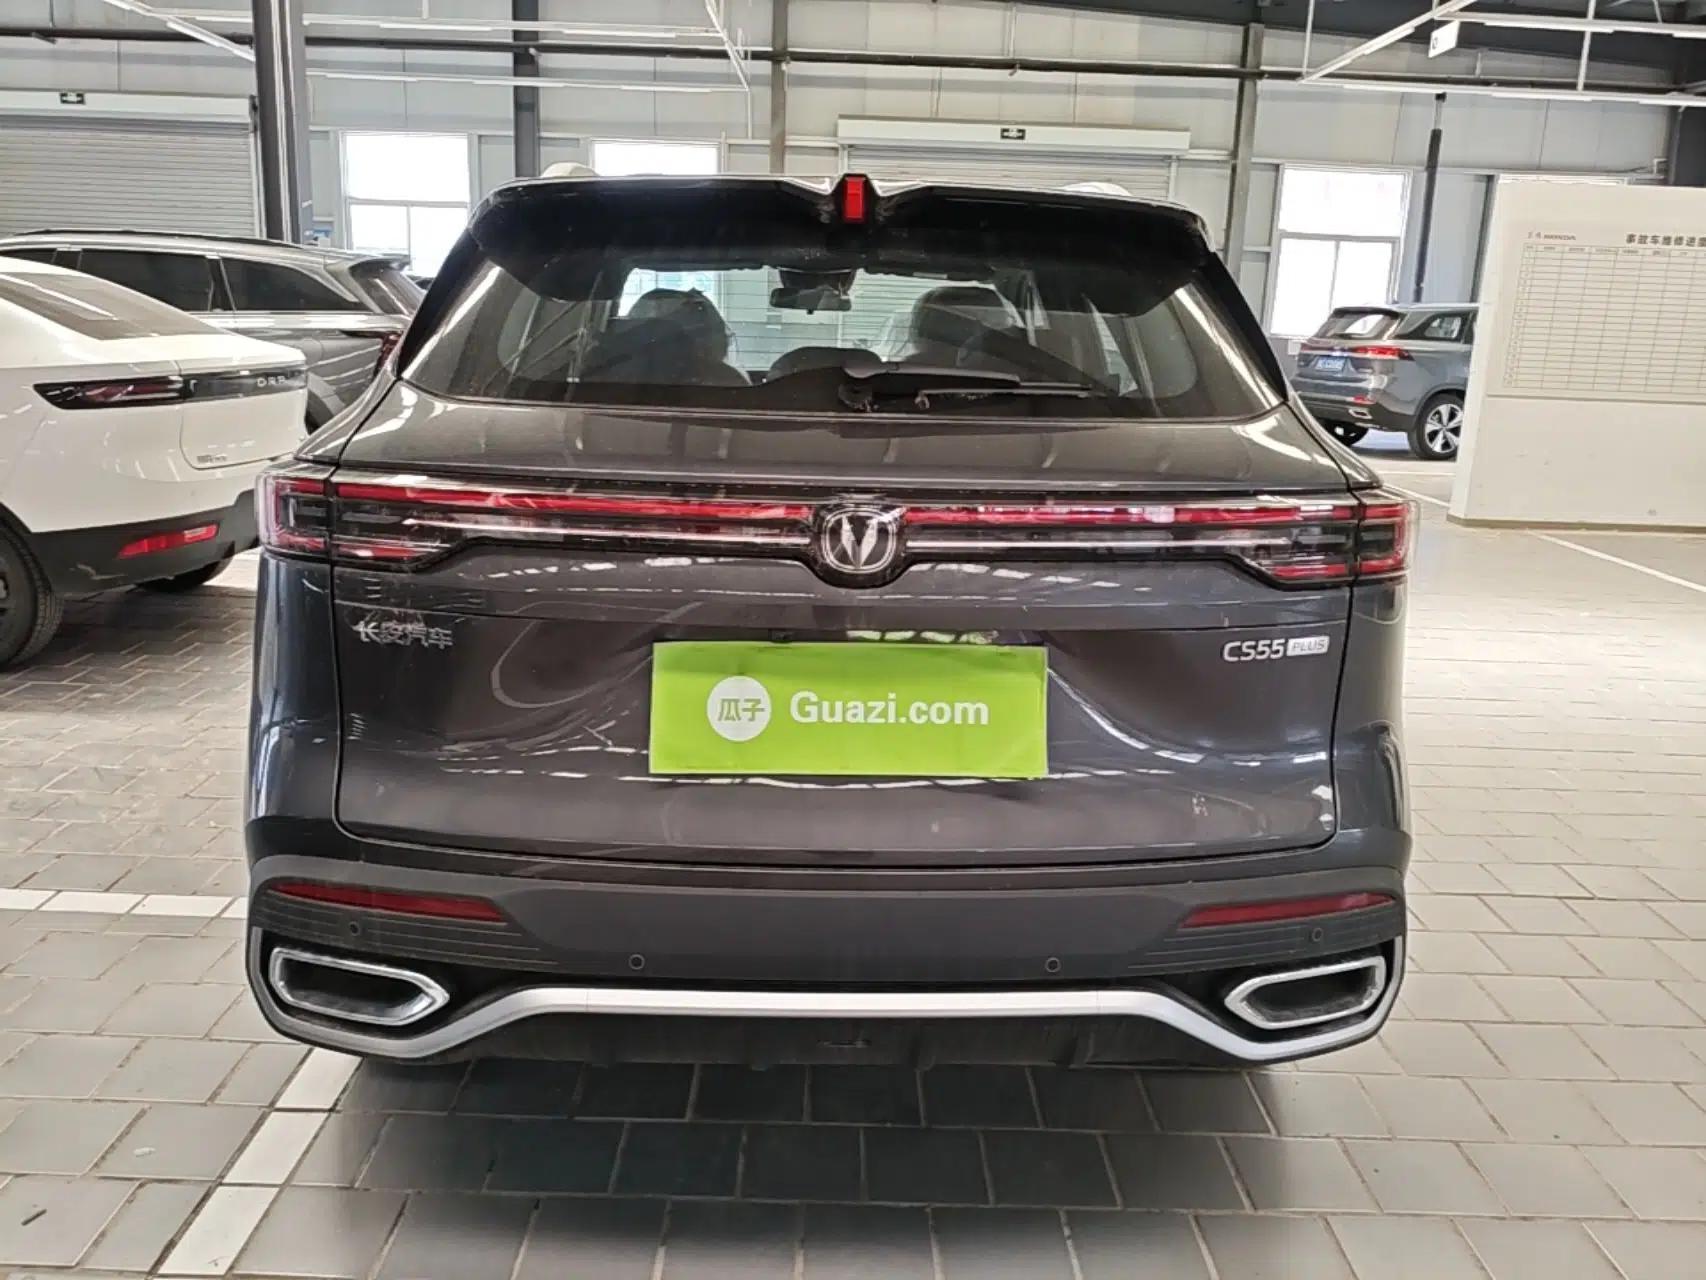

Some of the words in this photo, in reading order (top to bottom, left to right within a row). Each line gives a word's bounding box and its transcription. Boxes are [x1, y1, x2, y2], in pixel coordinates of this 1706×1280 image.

[1223, 638, 1285, 662] CS55
[1290, 638, 1327, 653] PLUS
[717, 697, 766, 723] 瓜子
[790, 691, 989, 725] Guazi.com
